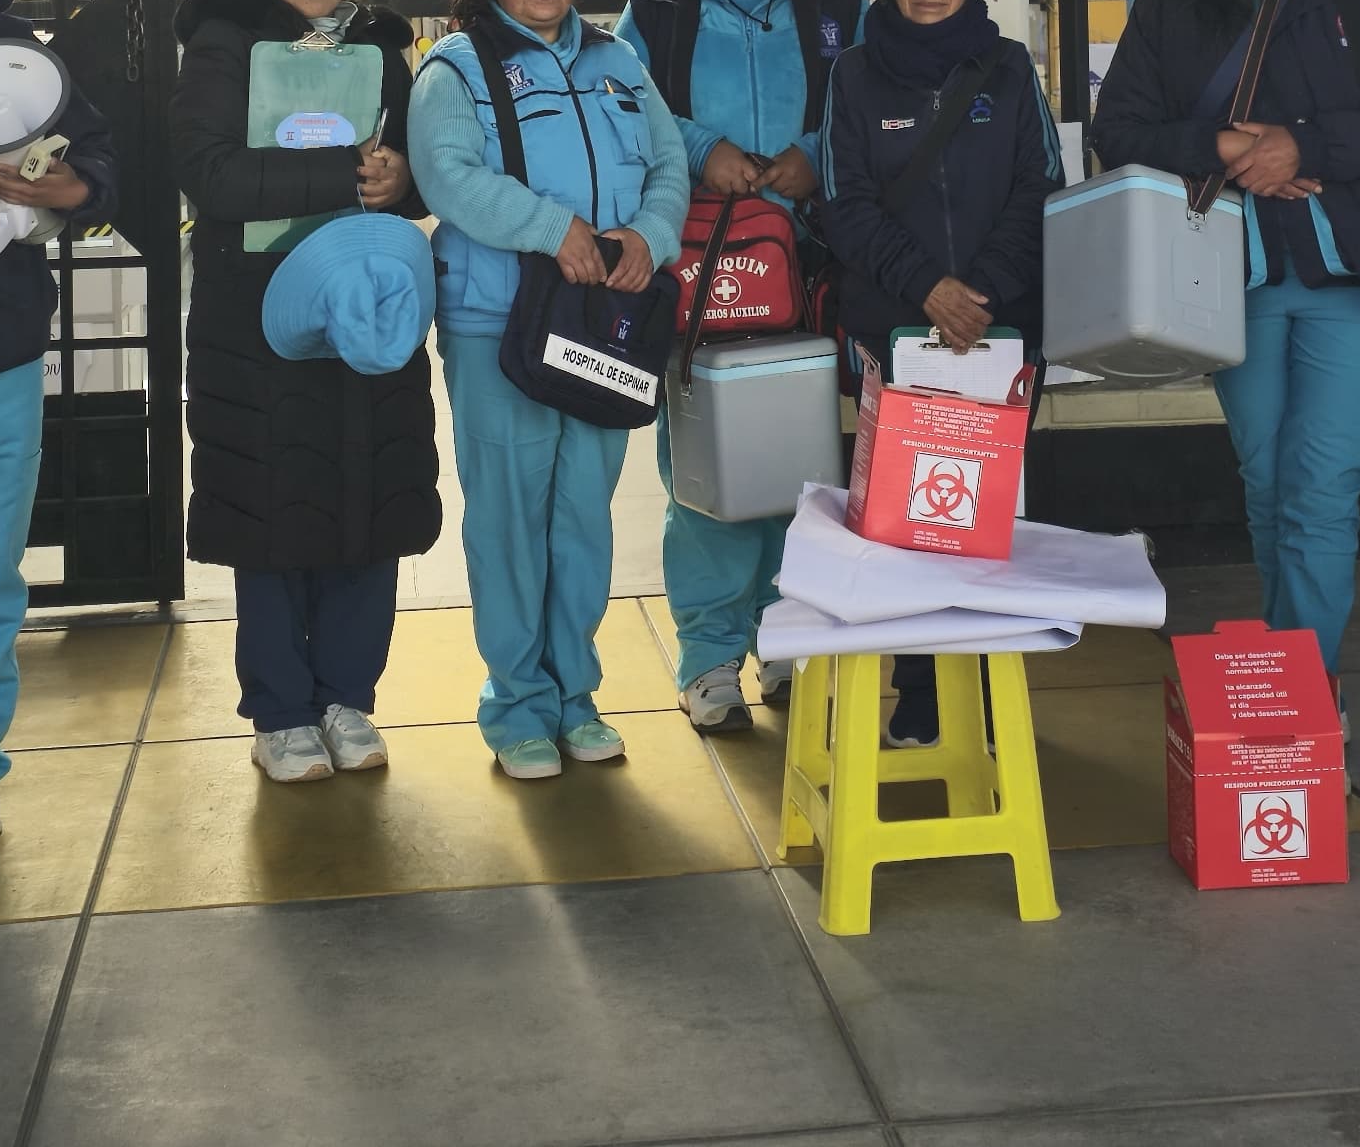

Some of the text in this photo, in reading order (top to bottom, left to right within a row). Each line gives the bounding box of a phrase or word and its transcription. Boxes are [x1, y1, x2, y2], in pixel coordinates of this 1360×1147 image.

[680, 257, 768, 283] BOIQUIN
[685, 306, 769, 321] PEROS AUXILIOS
[563, 347, 649, 394] HOSPITAL DE ESPINAR
